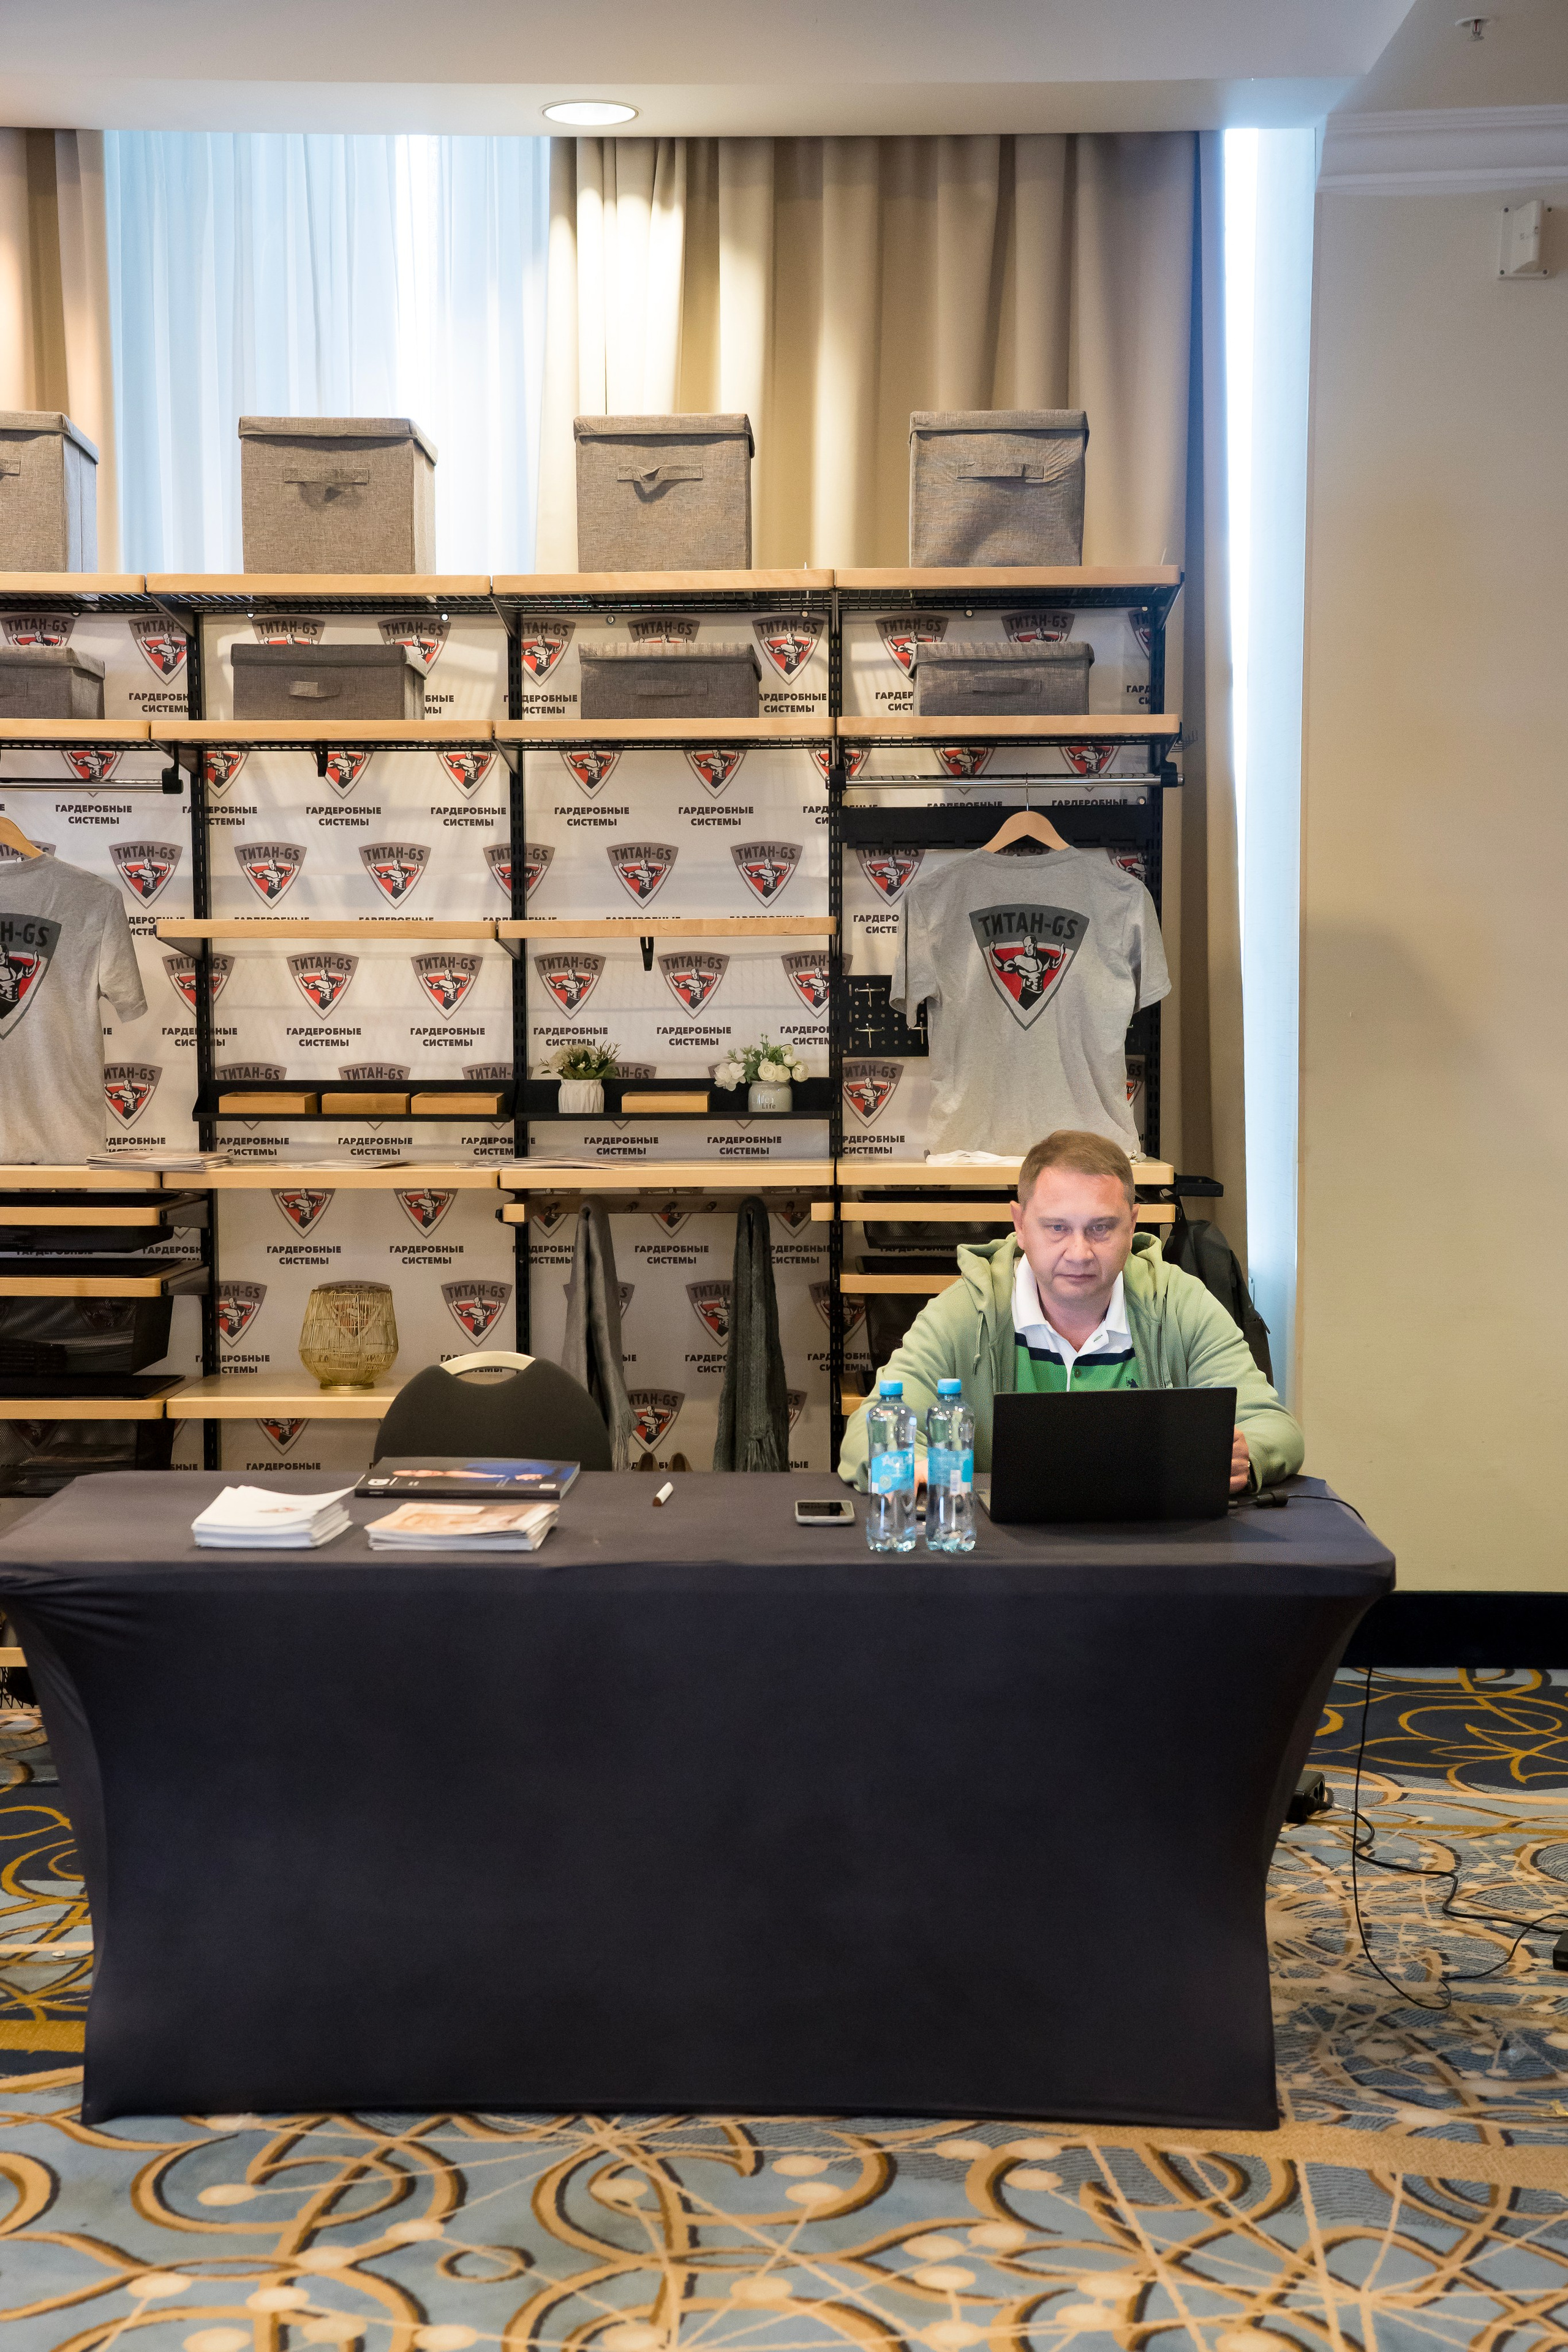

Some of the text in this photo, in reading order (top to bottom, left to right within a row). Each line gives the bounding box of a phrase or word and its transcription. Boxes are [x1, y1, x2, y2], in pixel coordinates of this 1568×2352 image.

[6, 617, 69, 633] ТИТАН-GS
[134, 620, 182, 634] ТИТАН-
[256, 621, 317, 636] ТИТАН-GS
[383, 621, 443, 636] ТИТАН-GS
[632, 620, 693, 636] ТИТАН-GS
[757, 619, 818, 635] ТИТАН-GS
[880, 618, 942, 632] ТИТАН-GS
[1008, 614, 1068, 629] ТИТАН-GS
[522, 622, 569, 637] ТАН-GS
[759, 693, 826, 702] АРДЕРОБНЫЕ
[56, 805, 132, 813] ГАРДЕРОБНЫЕ
[679, 807, 753, 815] ГАРДЕРОБНЫЕ
[115, 846, 176, 860] ТИТАН-GS
[240, 847, 300, 861] ТИТАН-GS
[364, 847, 424, 861] ТИТАН-GS
[488, 846, 548, 861] ТИТ-GS
[612, 846, 672, 861] ТИТАН-GS
[736, 845, 796, 860] ТИТАН-GS
[979, 911, 1078, 940] ТИТАН-GS
[292, 957, 352, 971] ТИТАН-GS
[416, 957, 477, 971] ТИТАН-GS
[540, 956, 599, 971] ТИТАН-GS
[663, 956, 723, 970] ТИТАН-GS
[533, 1027, 608, 1036] ГАРДЕРОБНЫЕ
[104, 1067, 156, 1081] ИТАН-GS
[220, 1067, 280, 1080] ТИТАН-GS
[344, 1067, 404, 1080] ТИТАН-GS
[467, 1067, 513, 1080] ТИТАН-
[461, 1137, 535, 1146] ГАРДЕРОБЕ
[143, 1246, 201, 1254] ГАРДЕРОБН
[447, 1285, 505, 1298] ТИТАН-GS
[692, 1286, 730, 1298] ТИТАН
[628, 1393, 678, 1406] ИТАН-GS
